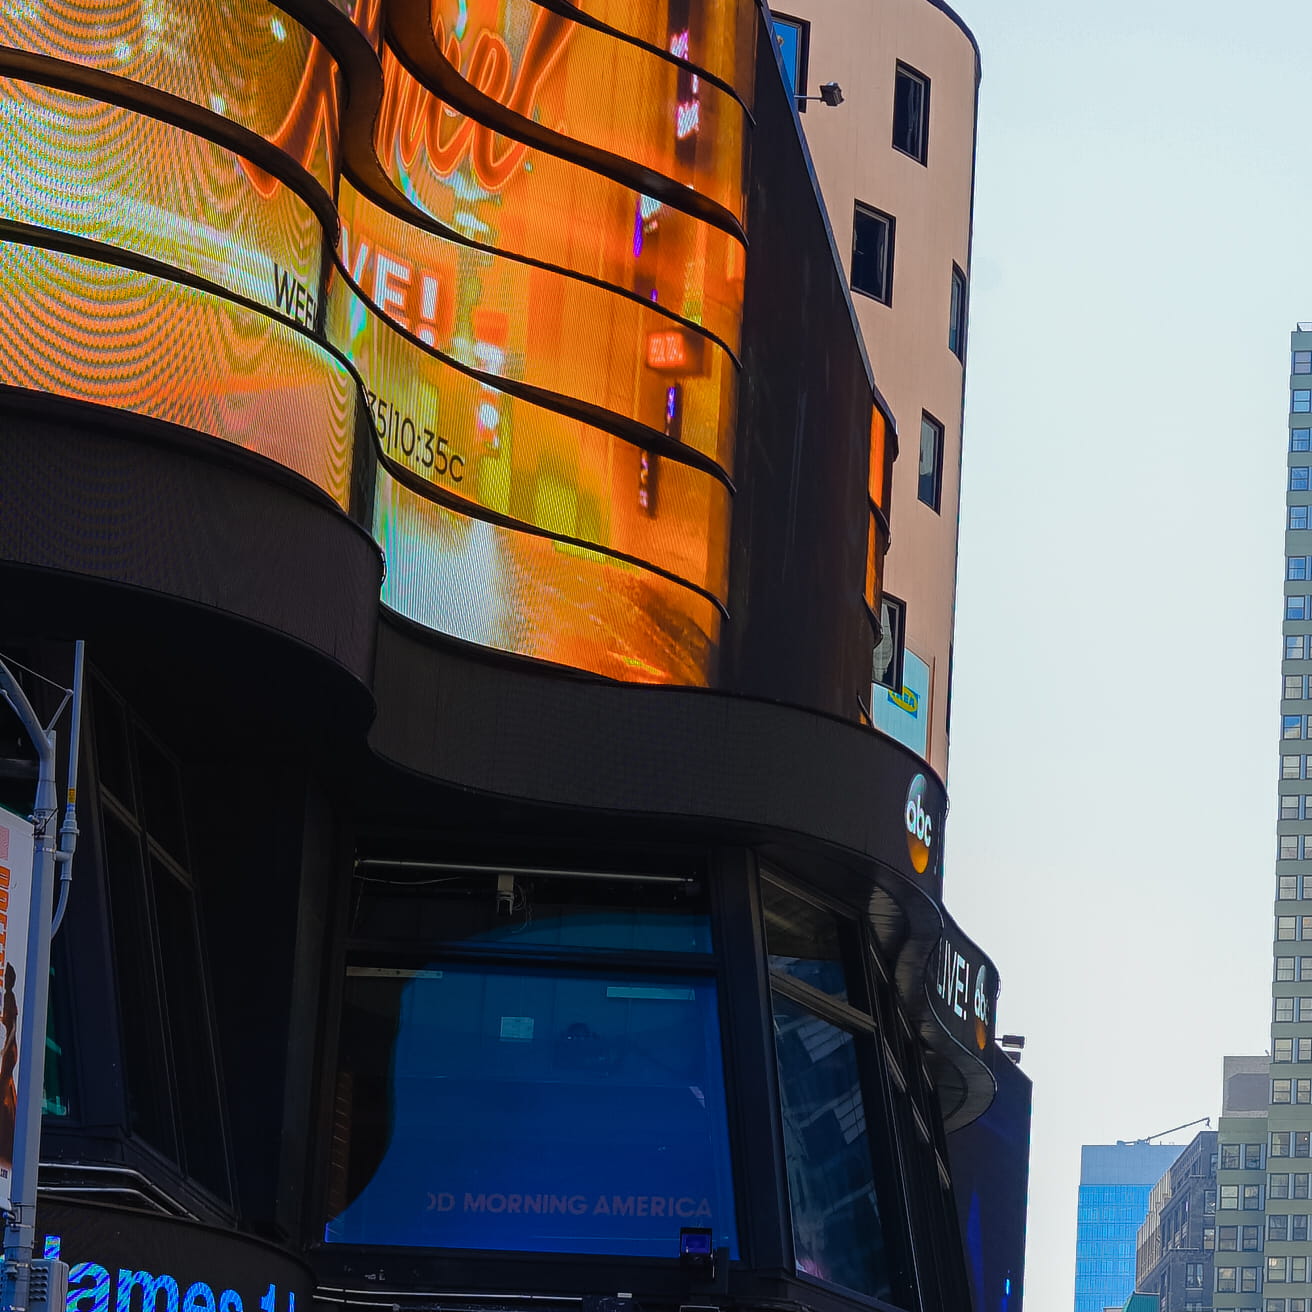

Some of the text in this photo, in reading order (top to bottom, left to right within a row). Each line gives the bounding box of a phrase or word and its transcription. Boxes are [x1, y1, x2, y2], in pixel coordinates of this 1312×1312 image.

[906, 795, 931, 849] abc
[937, 936, 970, 1021] LIVE!
[463, 1191, 713, 1218] MORNING AMERICA
